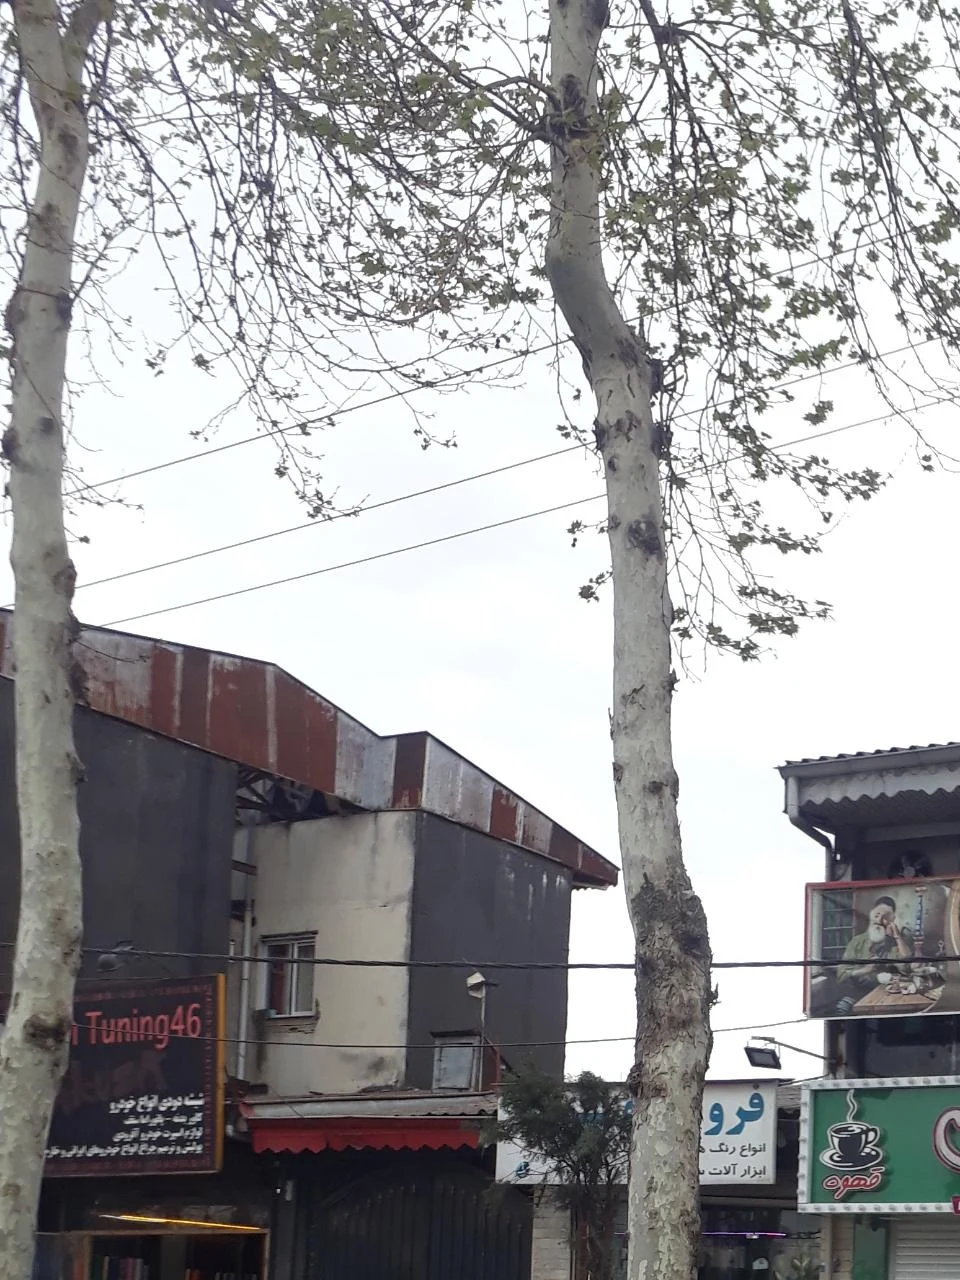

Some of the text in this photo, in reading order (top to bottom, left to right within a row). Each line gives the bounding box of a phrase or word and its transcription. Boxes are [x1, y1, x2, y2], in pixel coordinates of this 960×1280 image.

[85, 1003, 202, 1049] Tuning46
[709, 1142, 736, 1156] رنگ
[739, 1143, 766, 1159] انواع
[707, 1163, 738, 1179] آلات
[741, 1166, 766, 1179] ابزار
[823, 1166, 885, 1199] قهوه
